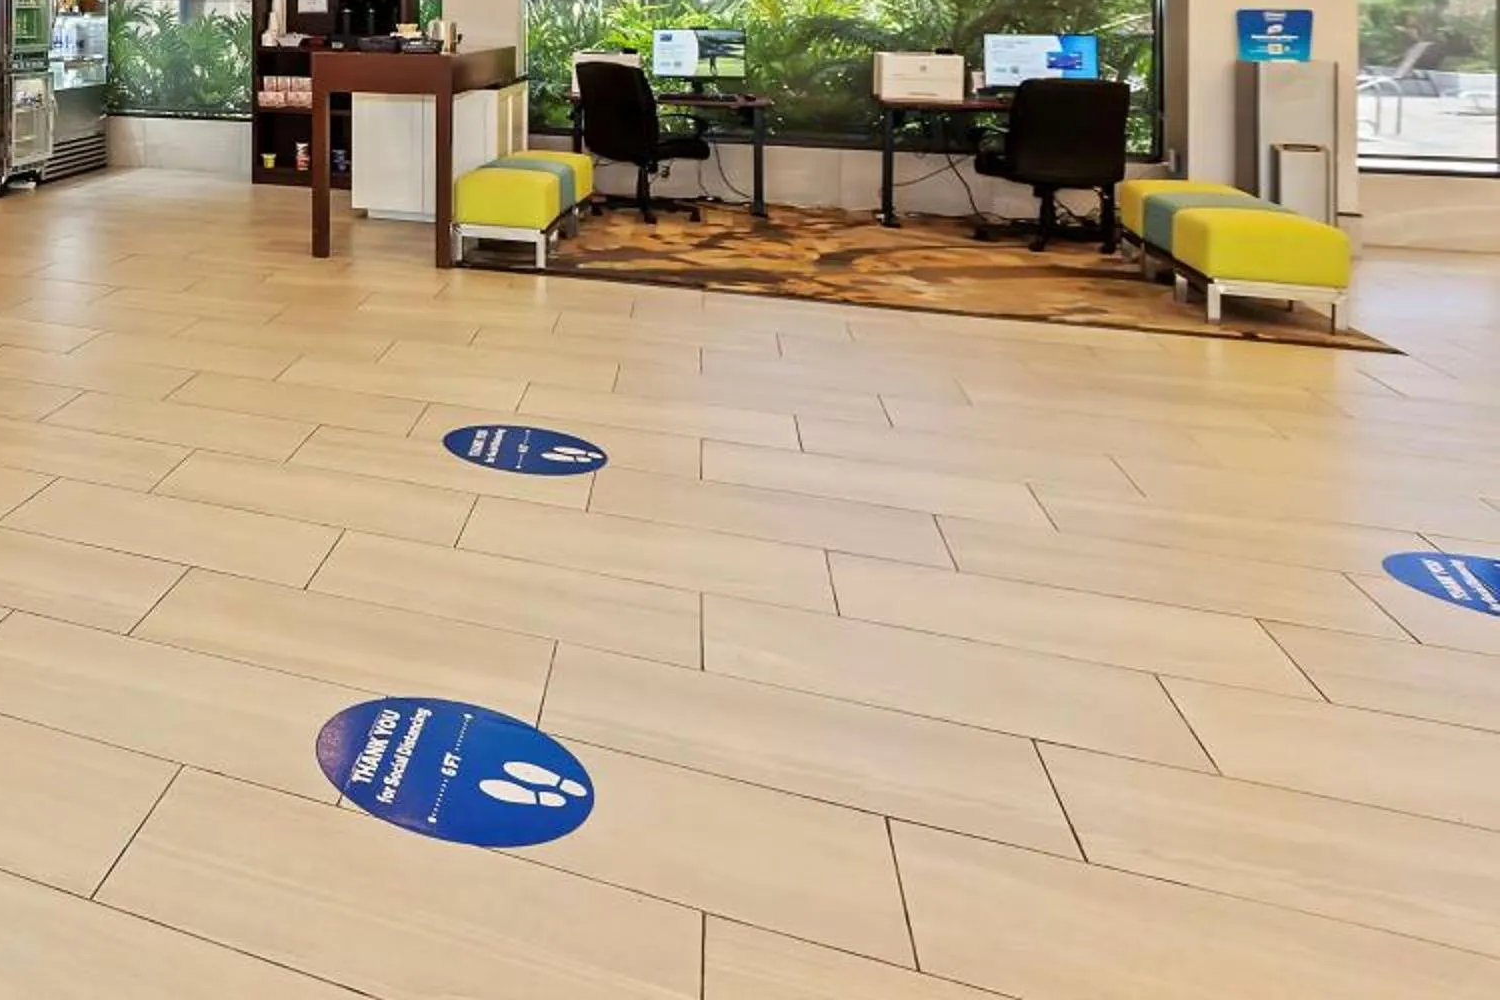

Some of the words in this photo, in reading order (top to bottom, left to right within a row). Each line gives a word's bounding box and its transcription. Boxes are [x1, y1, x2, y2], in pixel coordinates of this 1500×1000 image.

[351, 736, 389, 783] THANK
[373, 709, 401, 736] YOU
[394, 707, 432, 756] Distancing
[382, 754, 410, 787] Social
[376, 785, 397, 804] for
